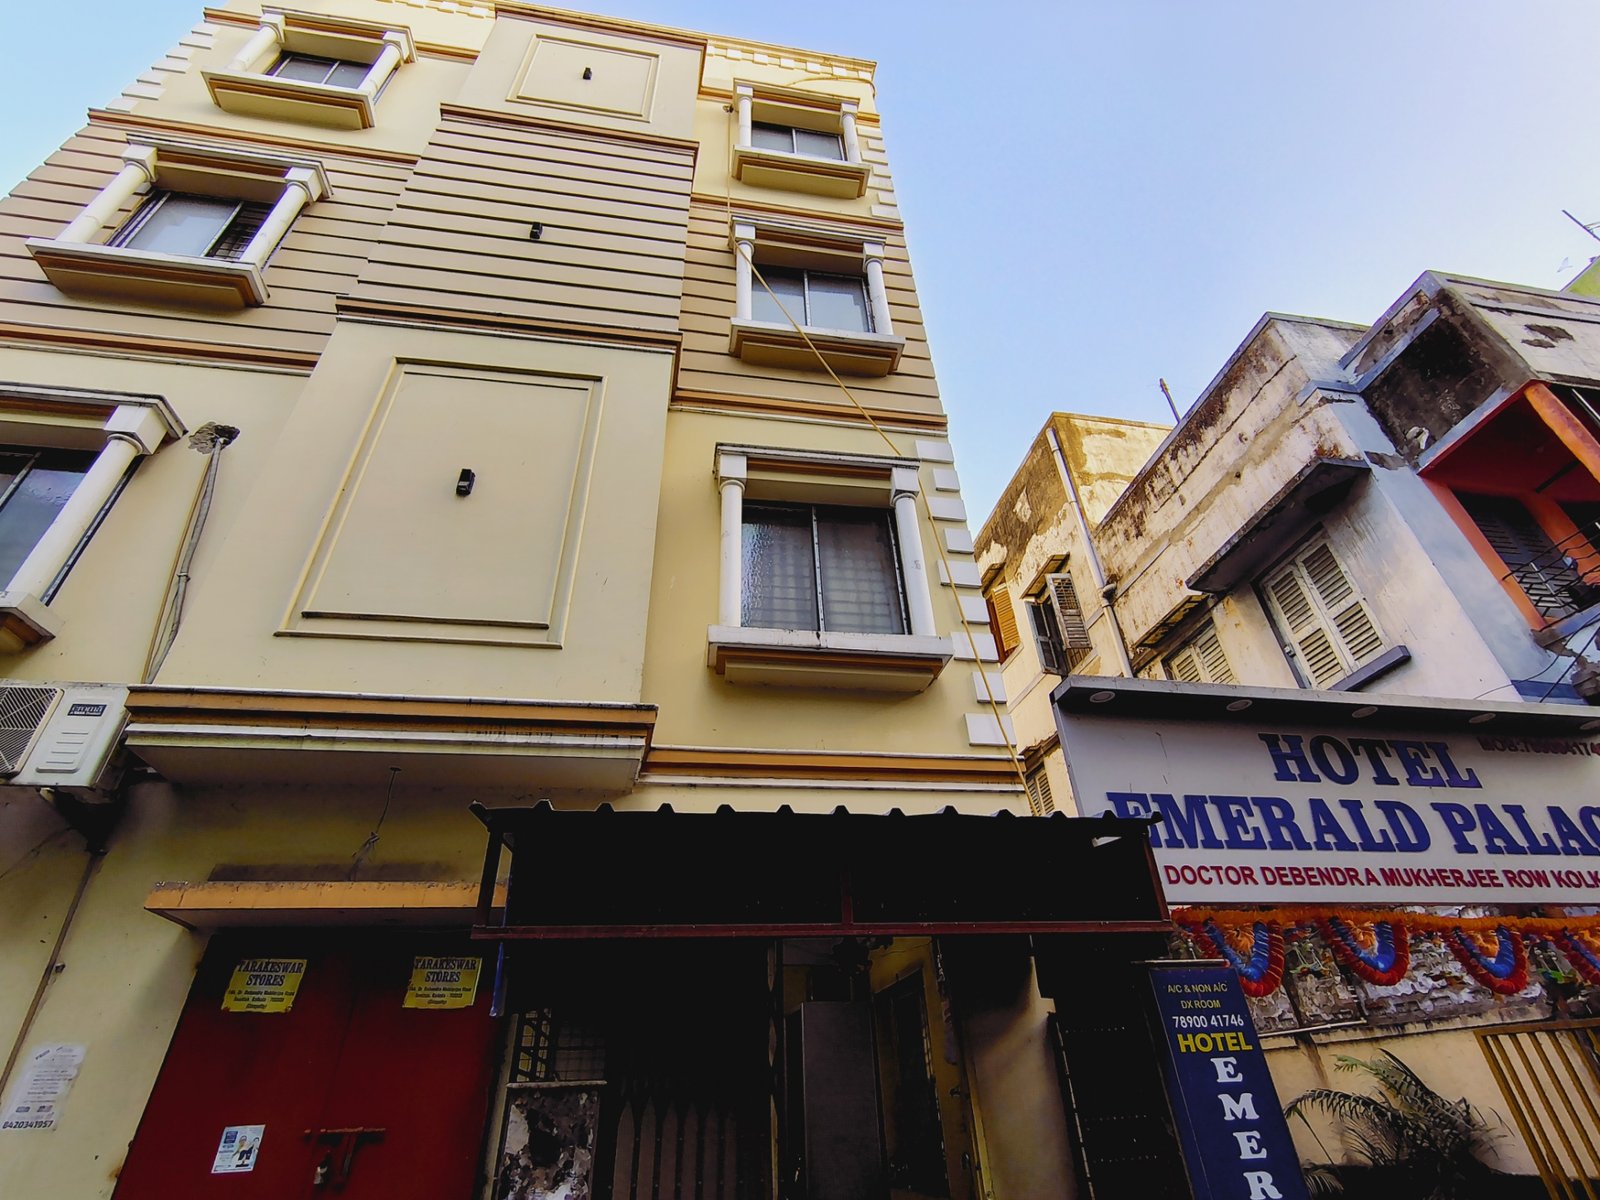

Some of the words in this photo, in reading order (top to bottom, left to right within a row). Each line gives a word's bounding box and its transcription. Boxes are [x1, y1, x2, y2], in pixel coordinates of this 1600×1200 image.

[1257, 733, 1483, 789] HOTEL
[1163, 864, 1259, 886] DOCTOR
[1260, 866, 1381, 886] DEBENDRA
[1379, 867, 1503, 888] MUKHERJEE
[1502, 869, 1551, 888] ROW
[246, 973, 286, 986] STORES
[425, 971, 461, 982] STORES
[1167, 984, 1183, 993] A/C
[1184, 984, 1191, 992] &
[1191, 984, 1212, 992] NON
[1213, 982, 1228, 992] A/C
[1180, 1000, 1193, 1009] DX
[1194, 1000, 1221, 1008] ROOM
[1172, 1015, 1208, 1028] 78900
[1210, 1014, 1244, 1027] 41746
[1177, 1032, 1253, 1053] HOTEL
